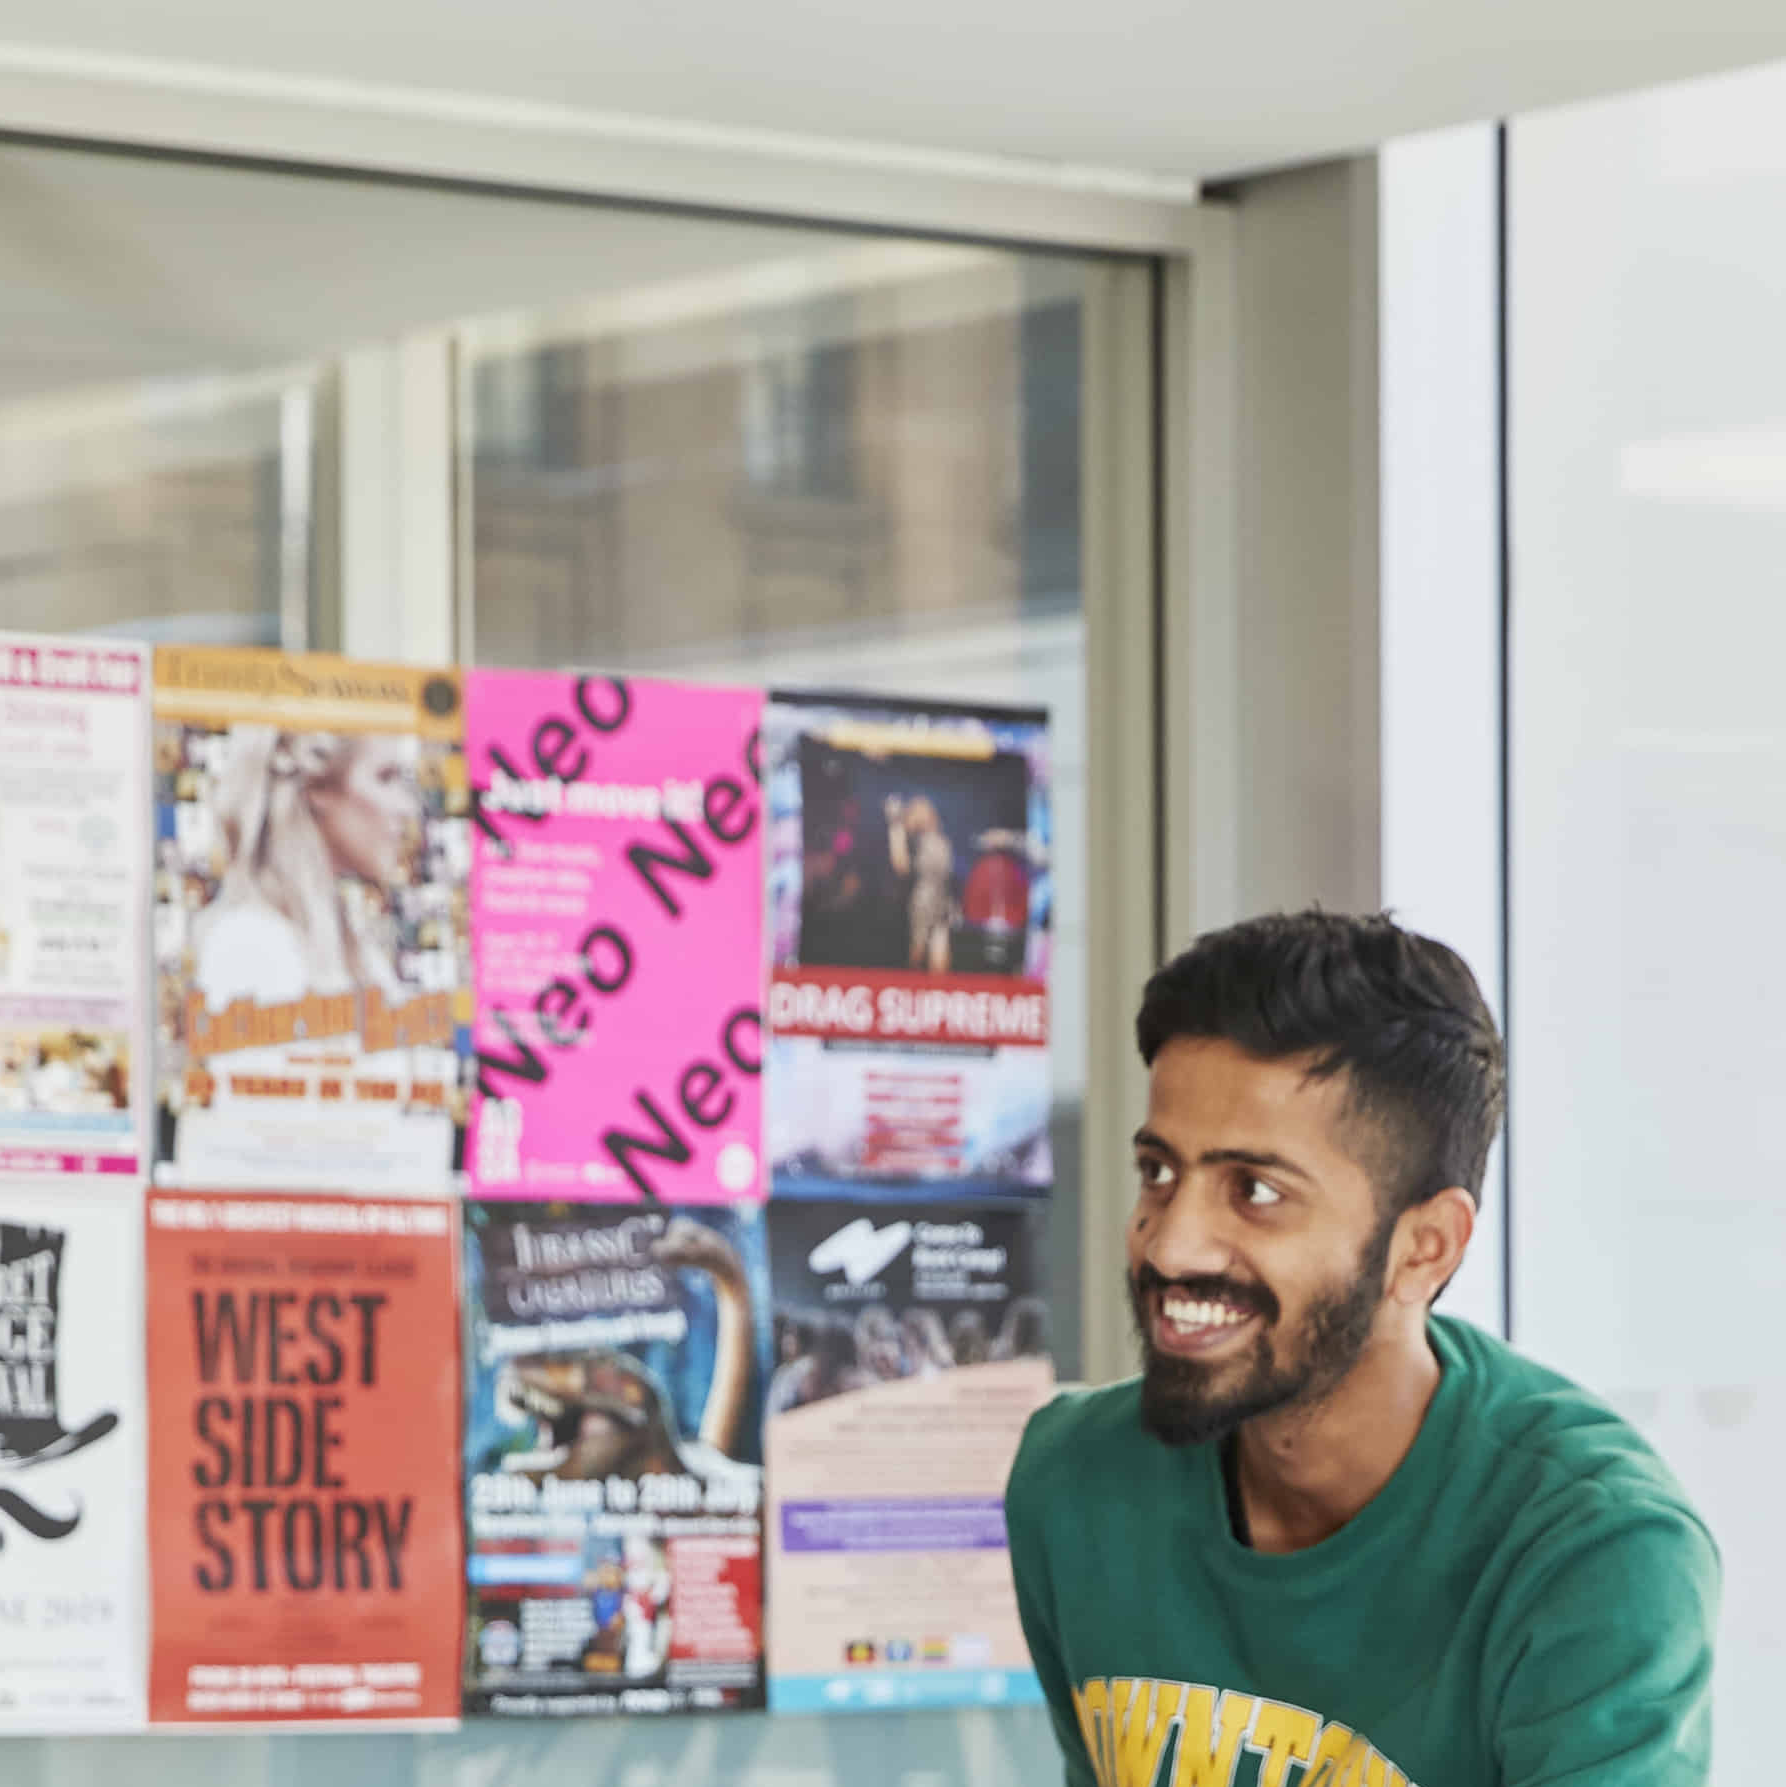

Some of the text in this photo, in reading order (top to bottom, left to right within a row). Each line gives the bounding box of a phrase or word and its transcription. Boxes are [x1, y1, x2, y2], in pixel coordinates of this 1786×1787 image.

[625, 724, 765, 918] Ne
[474, 927, 634, 1101] Neo
[771, 981, 1045, 1041] DRAG SUPREME
[600, 1004, 765, 1200] Neo
[192, 1287, 390, 1387] WEST
[191, 1396, 346, 1490] SIDE
[194, 1494, 416, 1592] STORY
